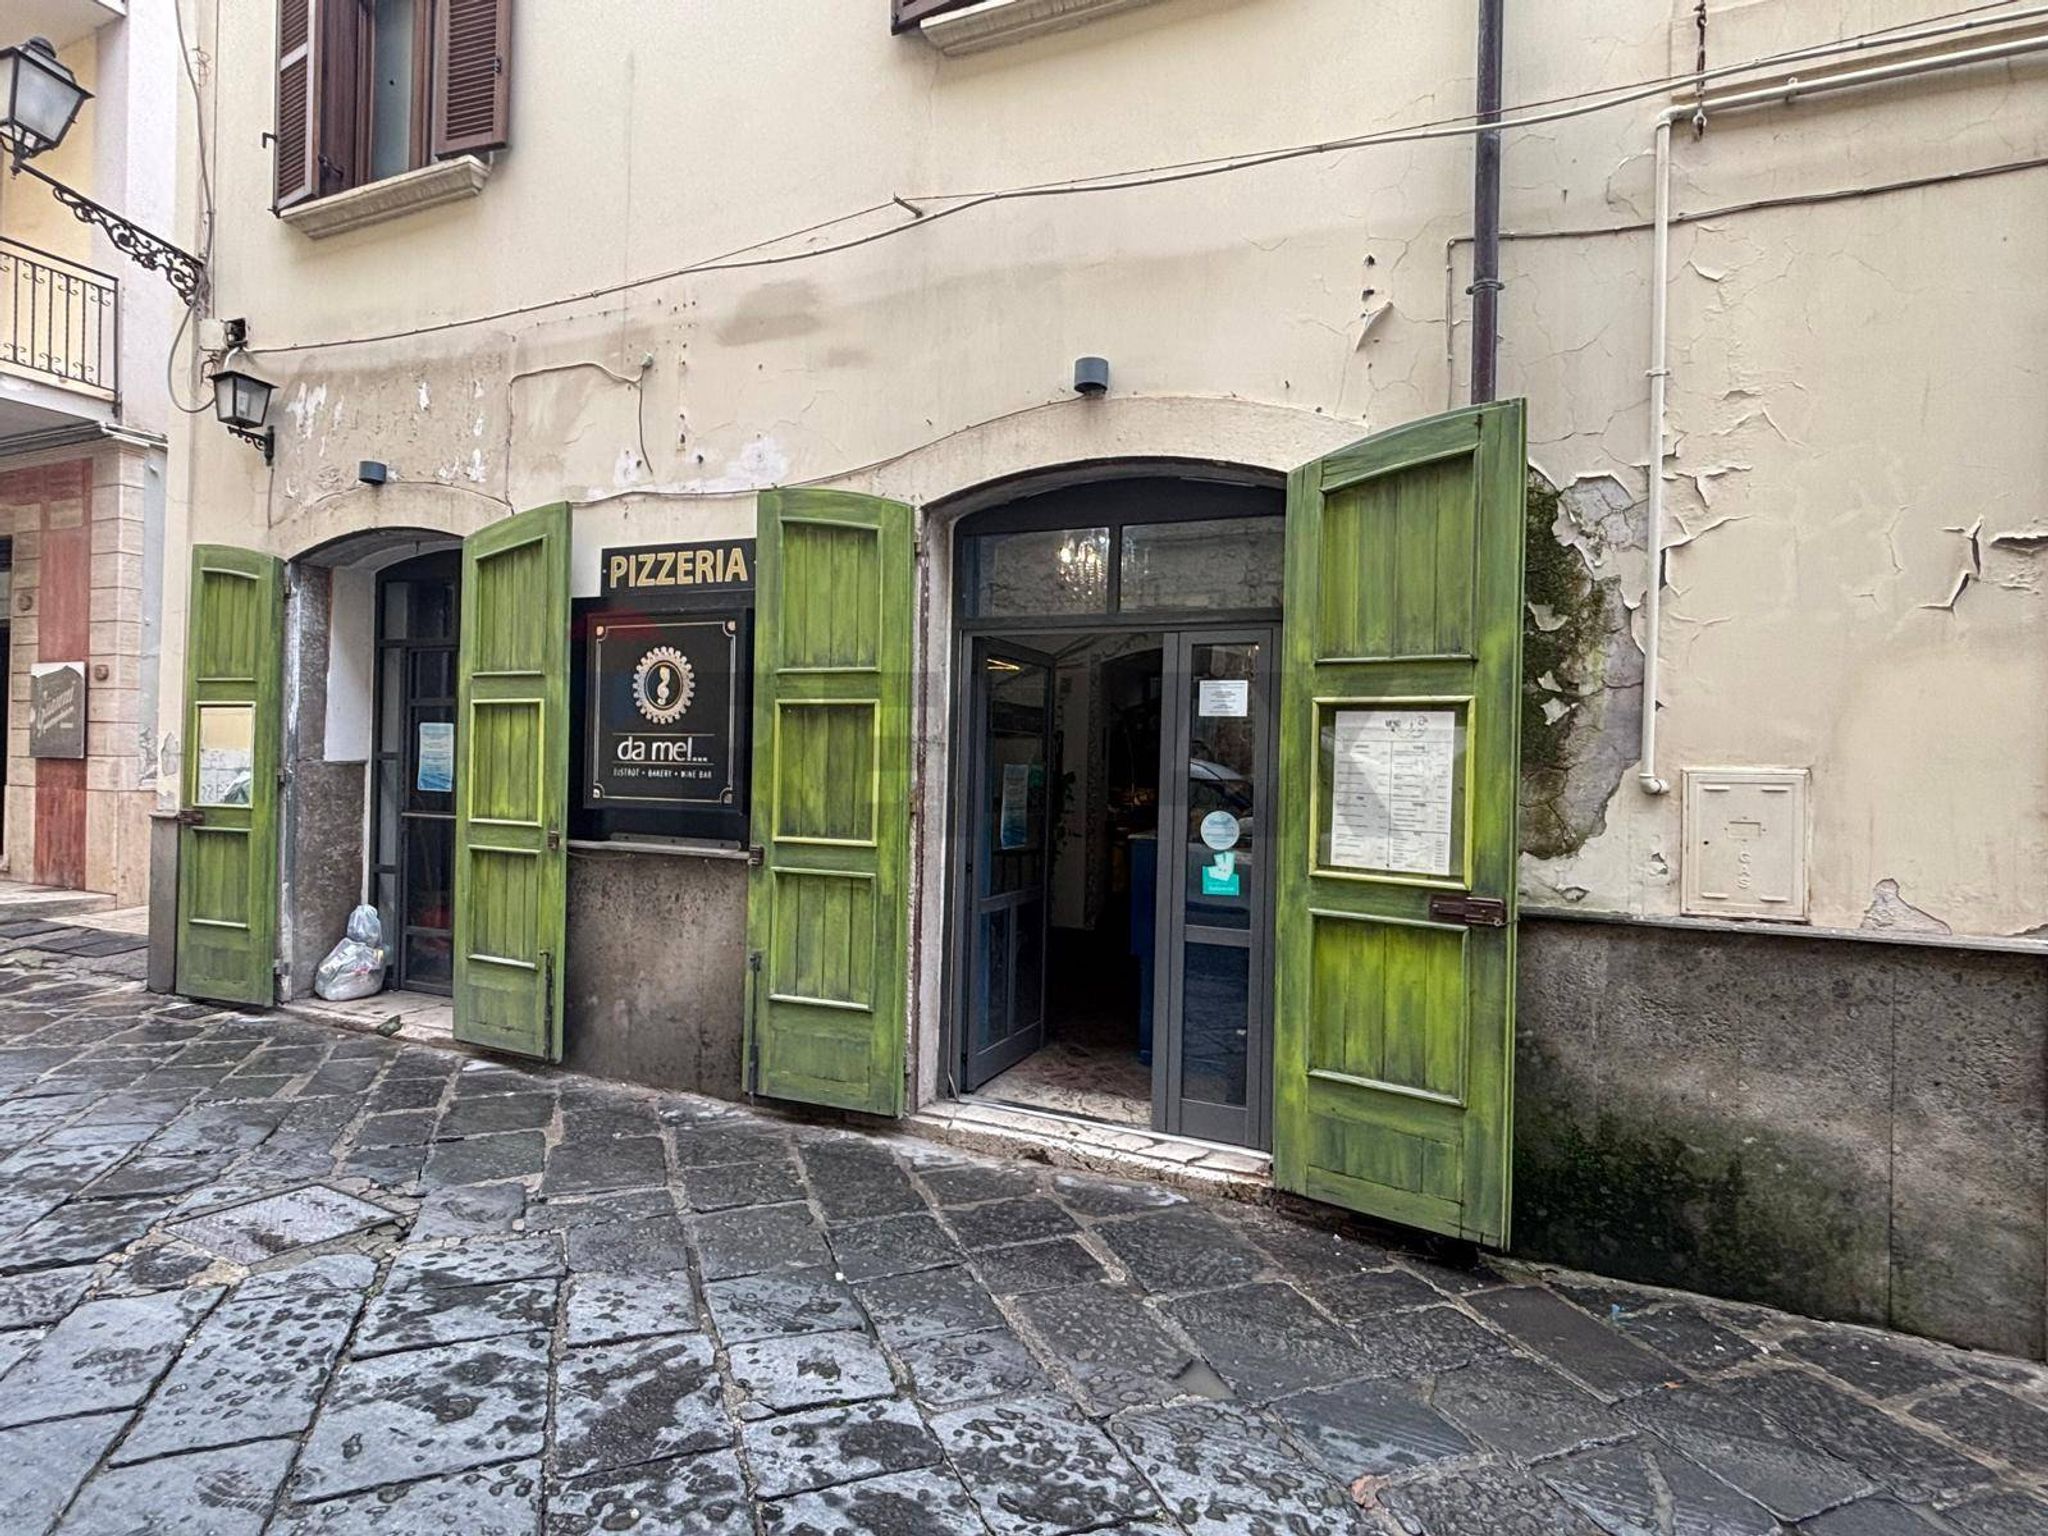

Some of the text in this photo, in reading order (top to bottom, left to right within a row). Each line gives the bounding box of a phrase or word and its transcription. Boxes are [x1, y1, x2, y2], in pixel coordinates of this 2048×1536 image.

[610, 547, 748, 588] PIZZERIA
[617, 736, 646, 761] da
[698, 770, 712, 779] BAR
